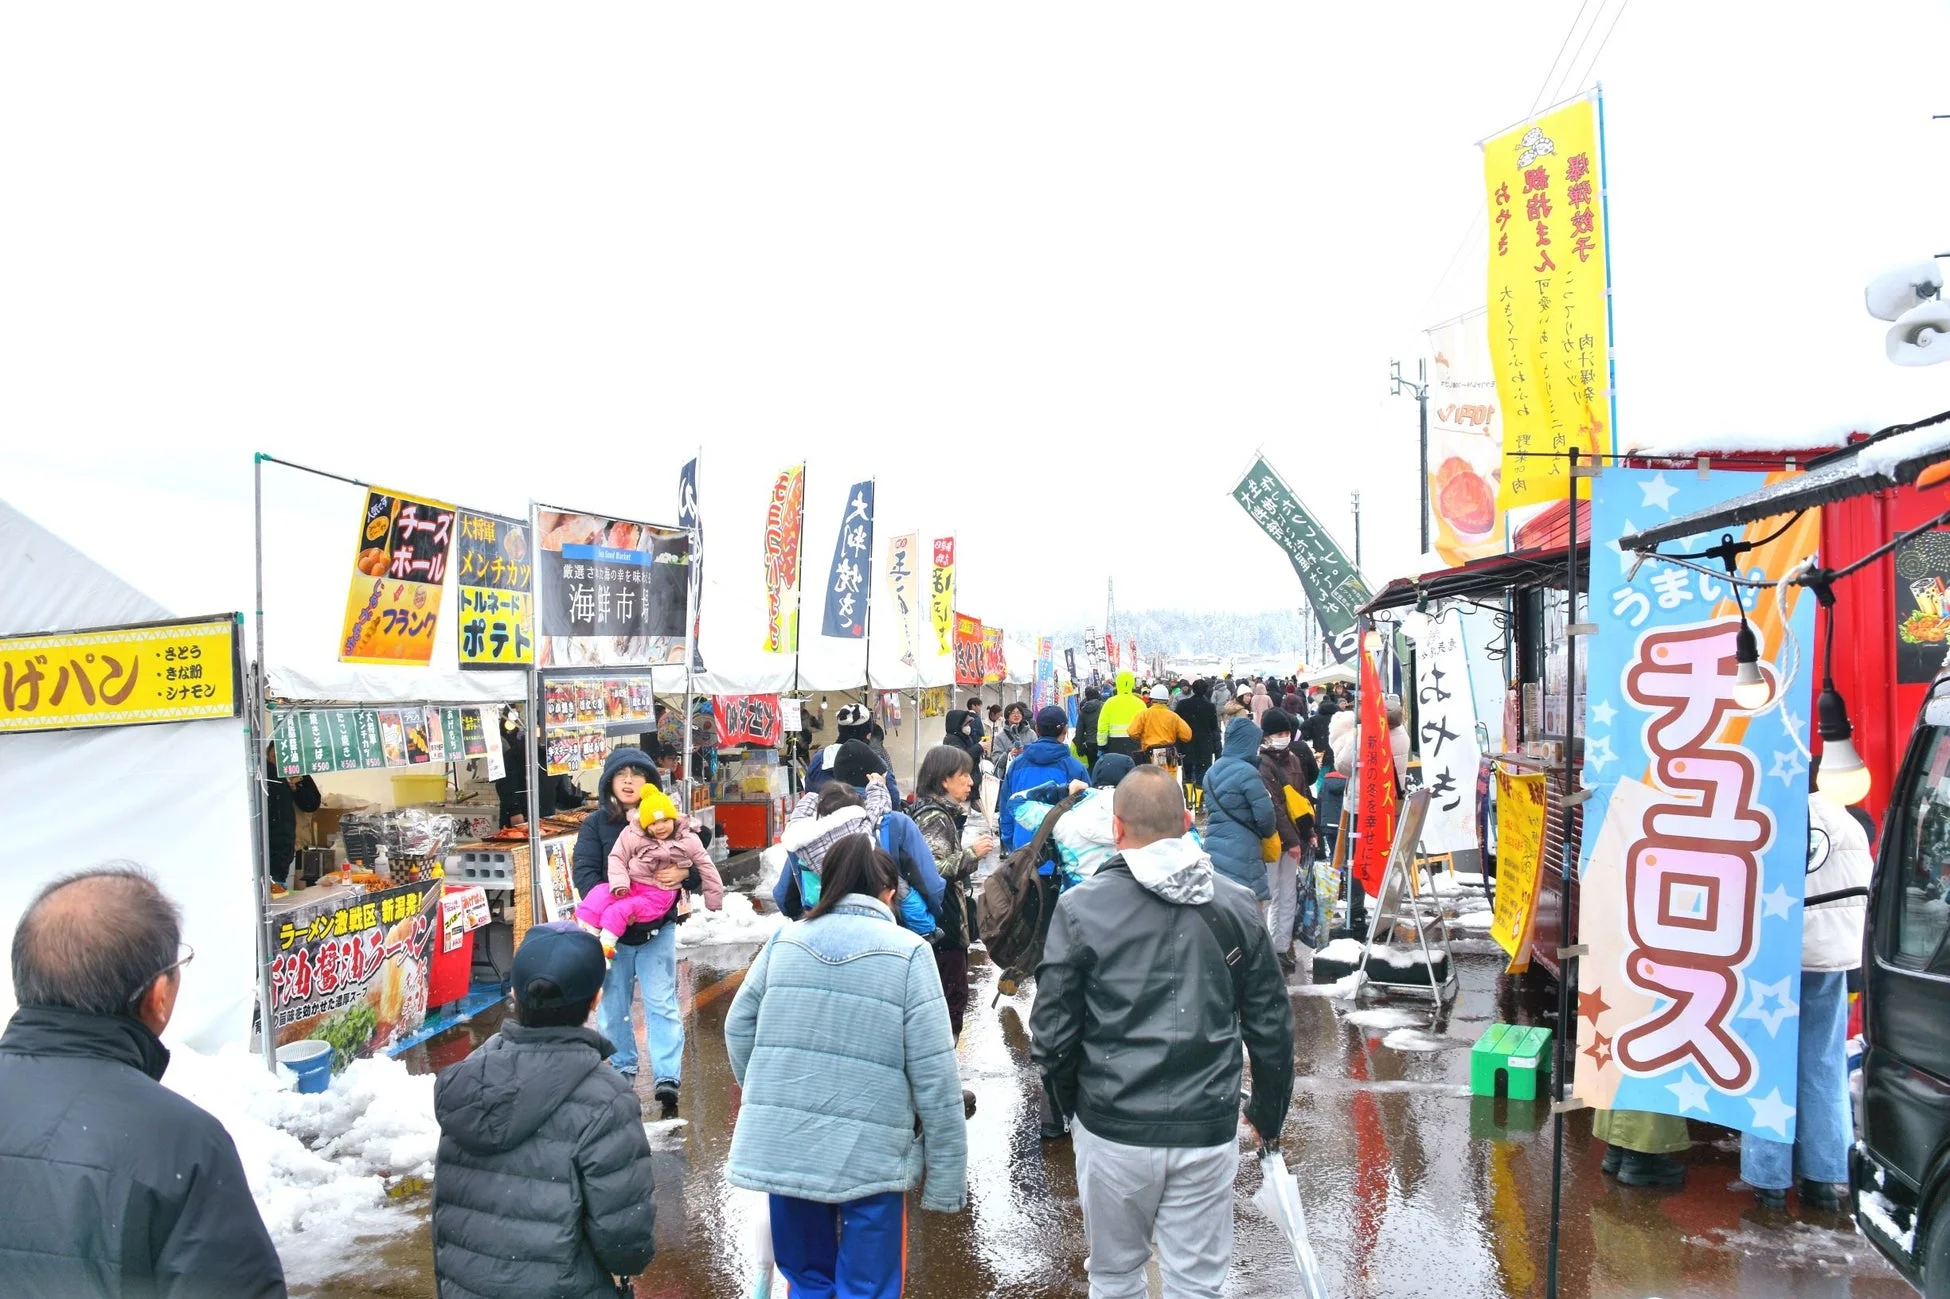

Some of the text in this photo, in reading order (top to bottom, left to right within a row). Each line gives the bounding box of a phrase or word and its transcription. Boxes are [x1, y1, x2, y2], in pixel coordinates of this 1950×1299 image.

[398, 506, 454, 546] チーズ
[461, 514, 496, 544] 大将軍
[391, 545, 445, 581] ボール
[460, 550, 531, 587] メンチカツ
[460, 590, 520, 616] トルネード
[568, 582, 650, 624] 海鮮市場
[383, 608, 437, 638] フランク
[463, 618, 531, 658] ポテト
[164, 644, 202, 661] さとう
[3, 653, 139, 712] げパン
[165, 664, 203, 680] きな粉
[165, 683, 216, 701] シナモン
[309, 713, 324, 760] 焼きそば
[311, 762, 330, 772] ¥500
[1618, 622, 1776, 1090] チュロス
[280, 902, 377, 950] ラーメン激戦区
